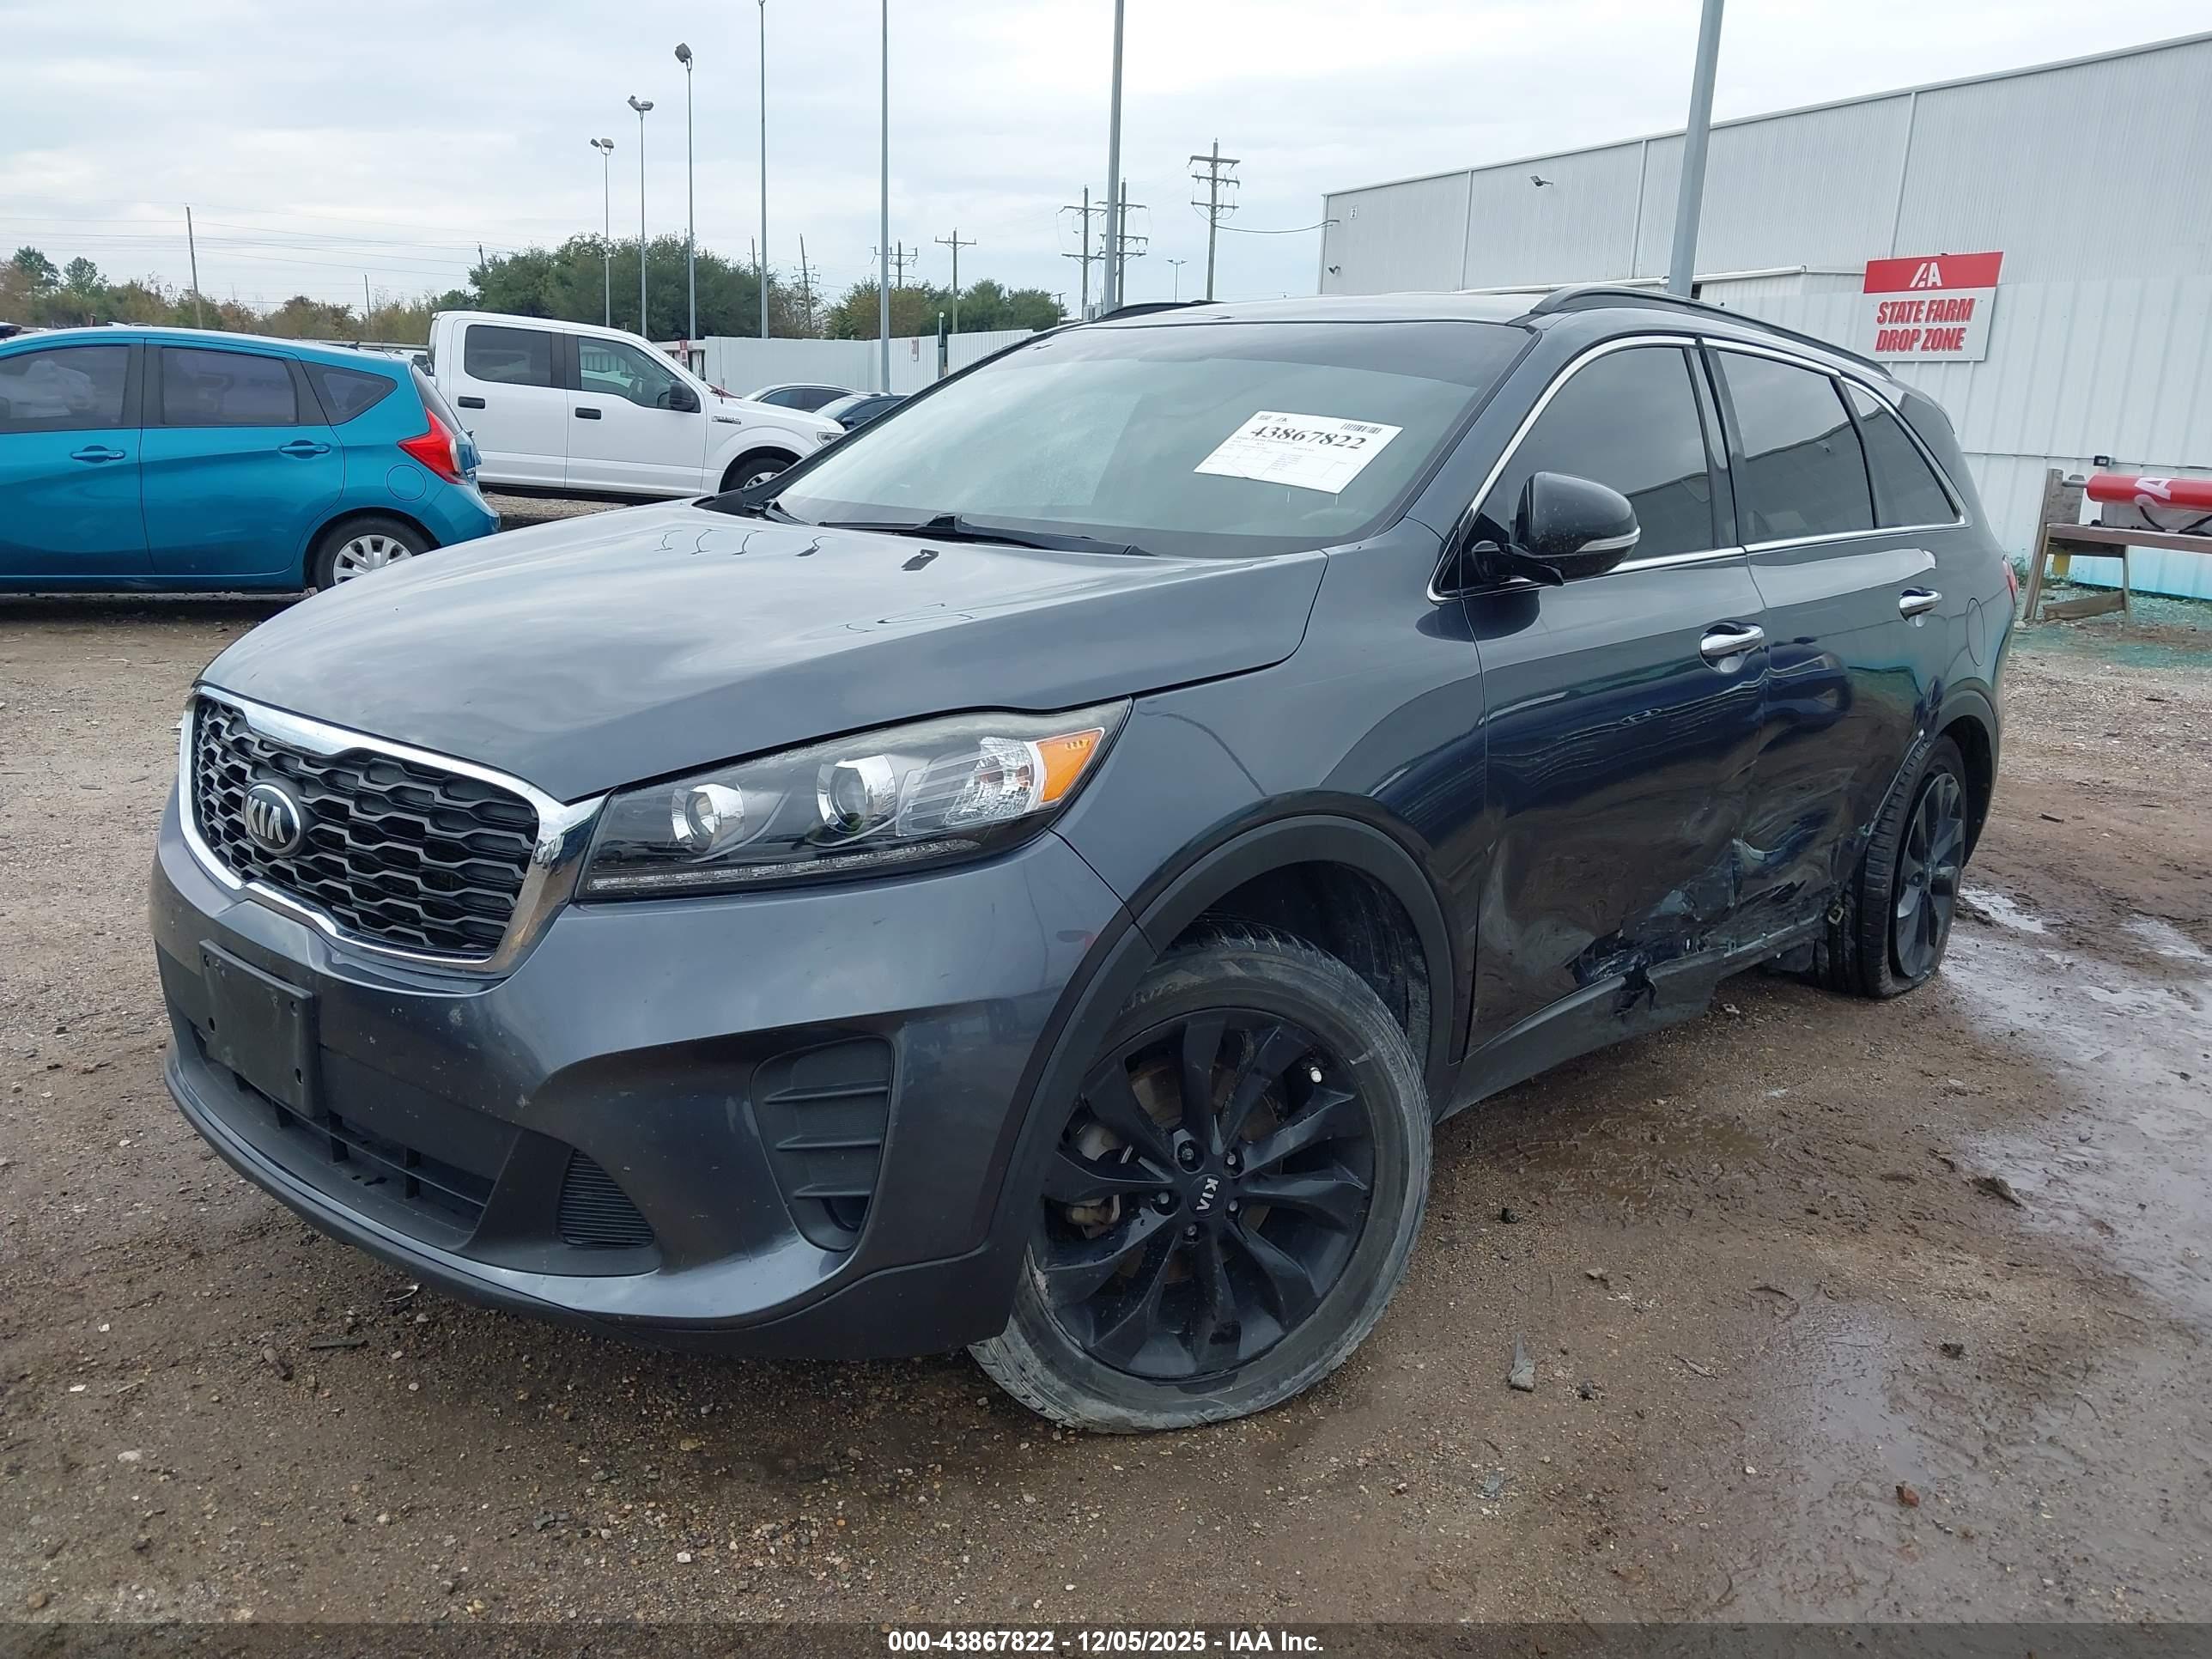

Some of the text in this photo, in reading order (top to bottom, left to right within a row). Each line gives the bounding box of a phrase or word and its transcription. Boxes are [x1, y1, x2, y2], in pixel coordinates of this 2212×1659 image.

[1876, 298, 1976, 325] STATE FARM
[1875, 327, 1967, 352] DROP ZONE
[1250, 424, 1366, 450] 43867822
[246, 795, 286, 844] KIA
[1195, 1177, 1219, 1211] KIA
